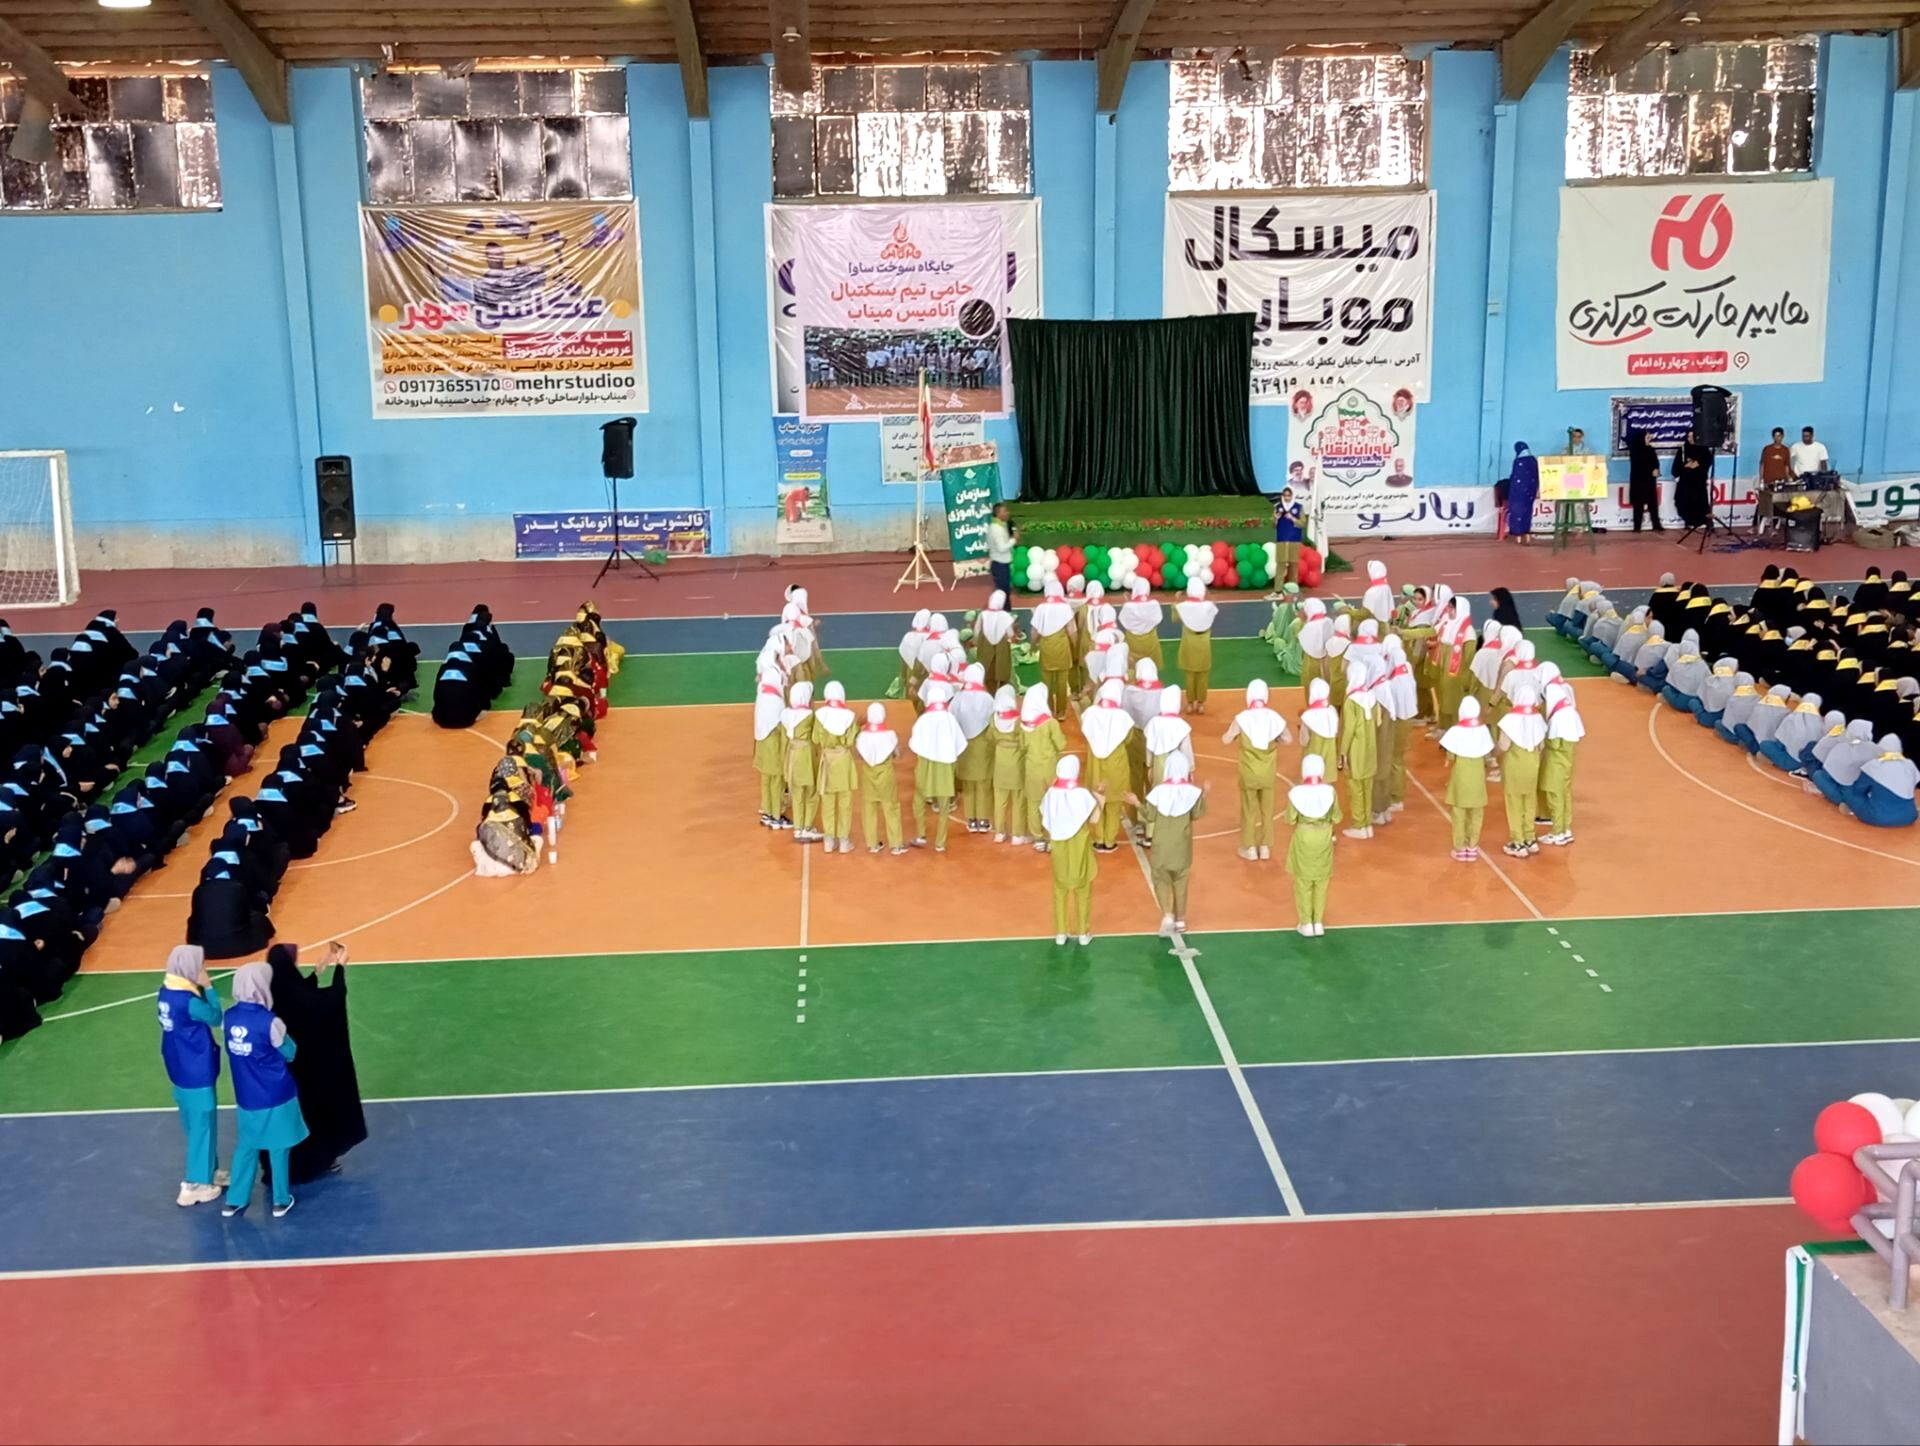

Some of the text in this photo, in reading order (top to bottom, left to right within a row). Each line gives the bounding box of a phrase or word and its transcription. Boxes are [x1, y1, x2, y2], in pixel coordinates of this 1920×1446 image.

[1184, 205, 1419, 273] میسکال
[848, 260, 954, 276] جایگاه سوخت ساوا
[831, 281, 973, 303] حامی تیم بسکتبال
[398, 284, 602, 329] عکاسی مهر
[847, 301, 956, 323] آنامیس میناب
[1569, 275, 1809, 339] هایپر مارکت مرکزی
[566, 345, 591, 355] داماد
[599, 346, 630, 357] عروس
[1631, 357, 1652, 372] امام
[1667, 356, 1691, 371] چهار
[1696, 355, 1724, 369] میناب
[399, 378, 501, 393] 09173655170
[516, 373, 635, 390] mehrstudioo
[956, 488, 991, 504] سازمان
[522, 519, 559, 534] پدر
[561, 515, 612, 533] اتوماتیک
